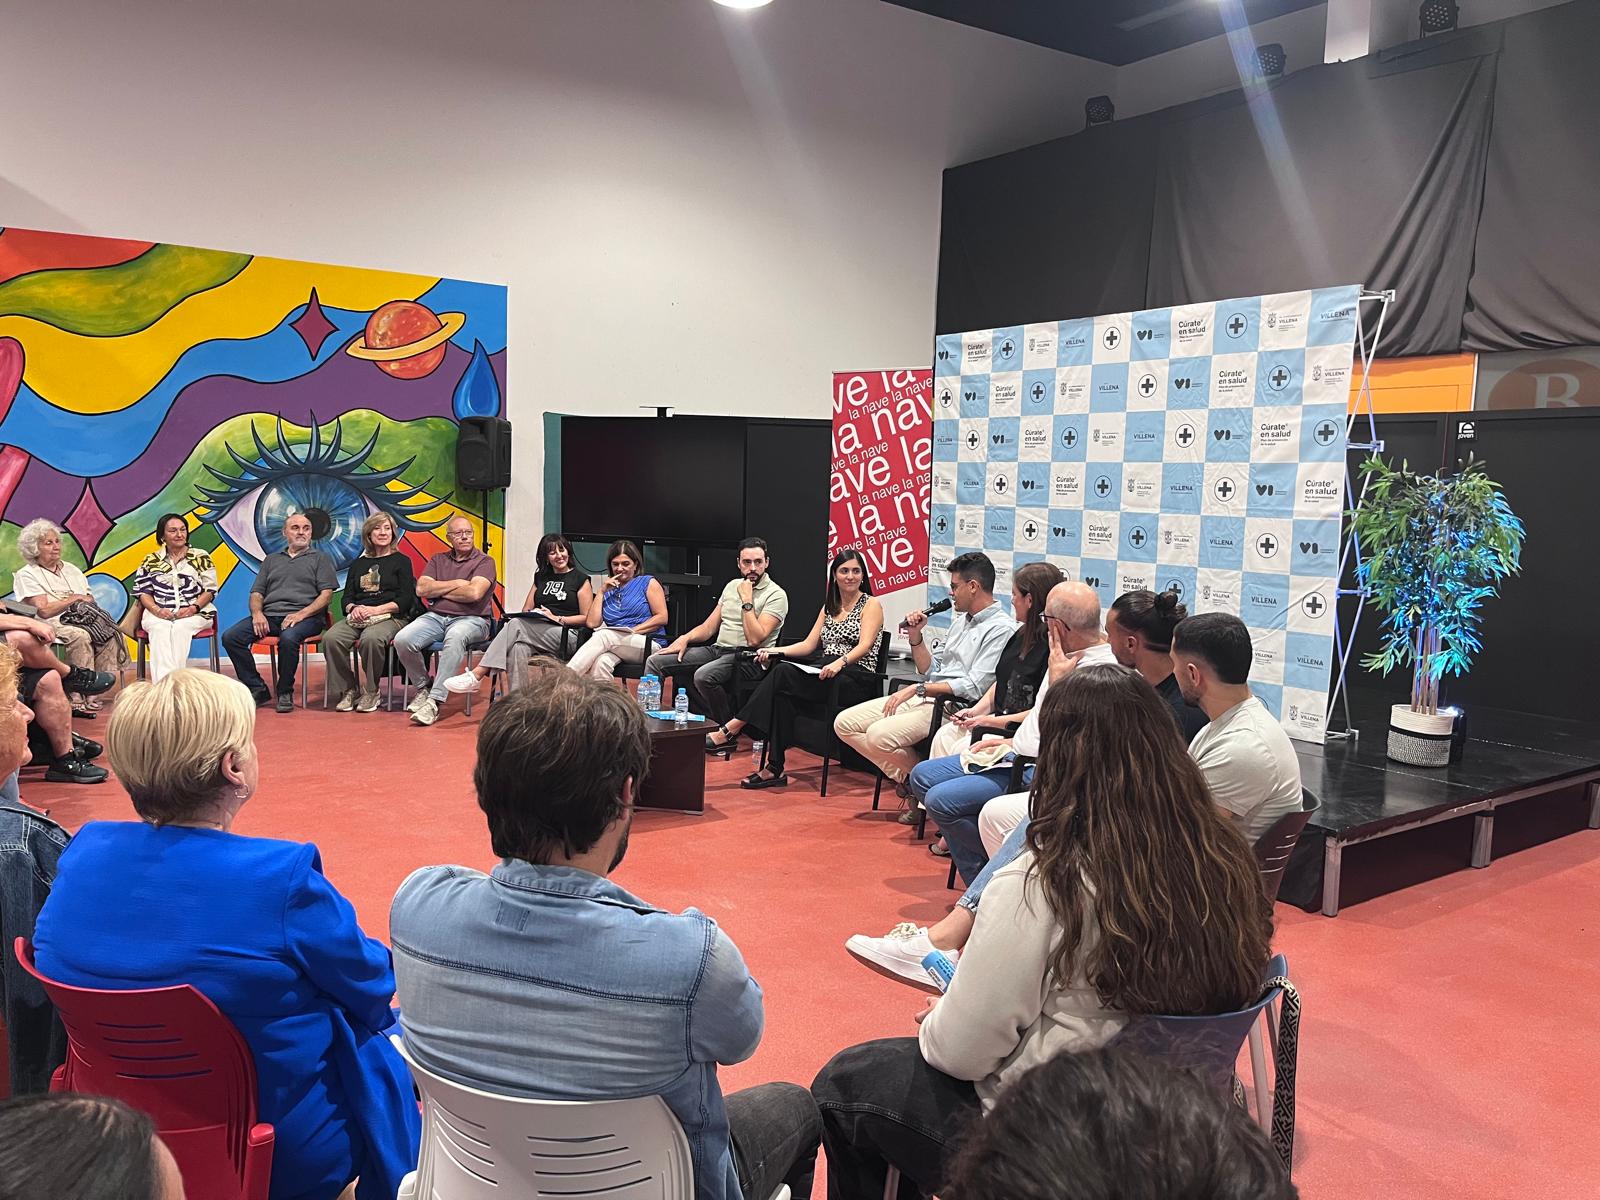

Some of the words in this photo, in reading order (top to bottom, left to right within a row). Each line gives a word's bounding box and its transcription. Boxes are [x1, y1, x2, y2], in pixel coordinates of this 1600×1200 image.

[1320, 310, 1350, 319] VILLENA
[849, 409, 860, 420] la
[862, 396, 889, 416] nave
[891, 390, 904, 402] la
[905, 378, 933, 396] nave
[848, 454, 859, 466] la
[861, 442, 888, 460] nave
[858, 494, 870, 505] la
[872, 483, 900, 500] nave
[902, 478, 914, 490] la
[846, 502, 885, 539] la
[865, 534, 876, 546] la
[879, 526, 907, 542] nave
[543, 581, 564, 595] 19
[874, 577, 886, 590] la
[888, 568, 916, 586] nave
[1251, 596, 1277, 604] VILLENA
[1297, 657, 1324, 666] VILLENA
